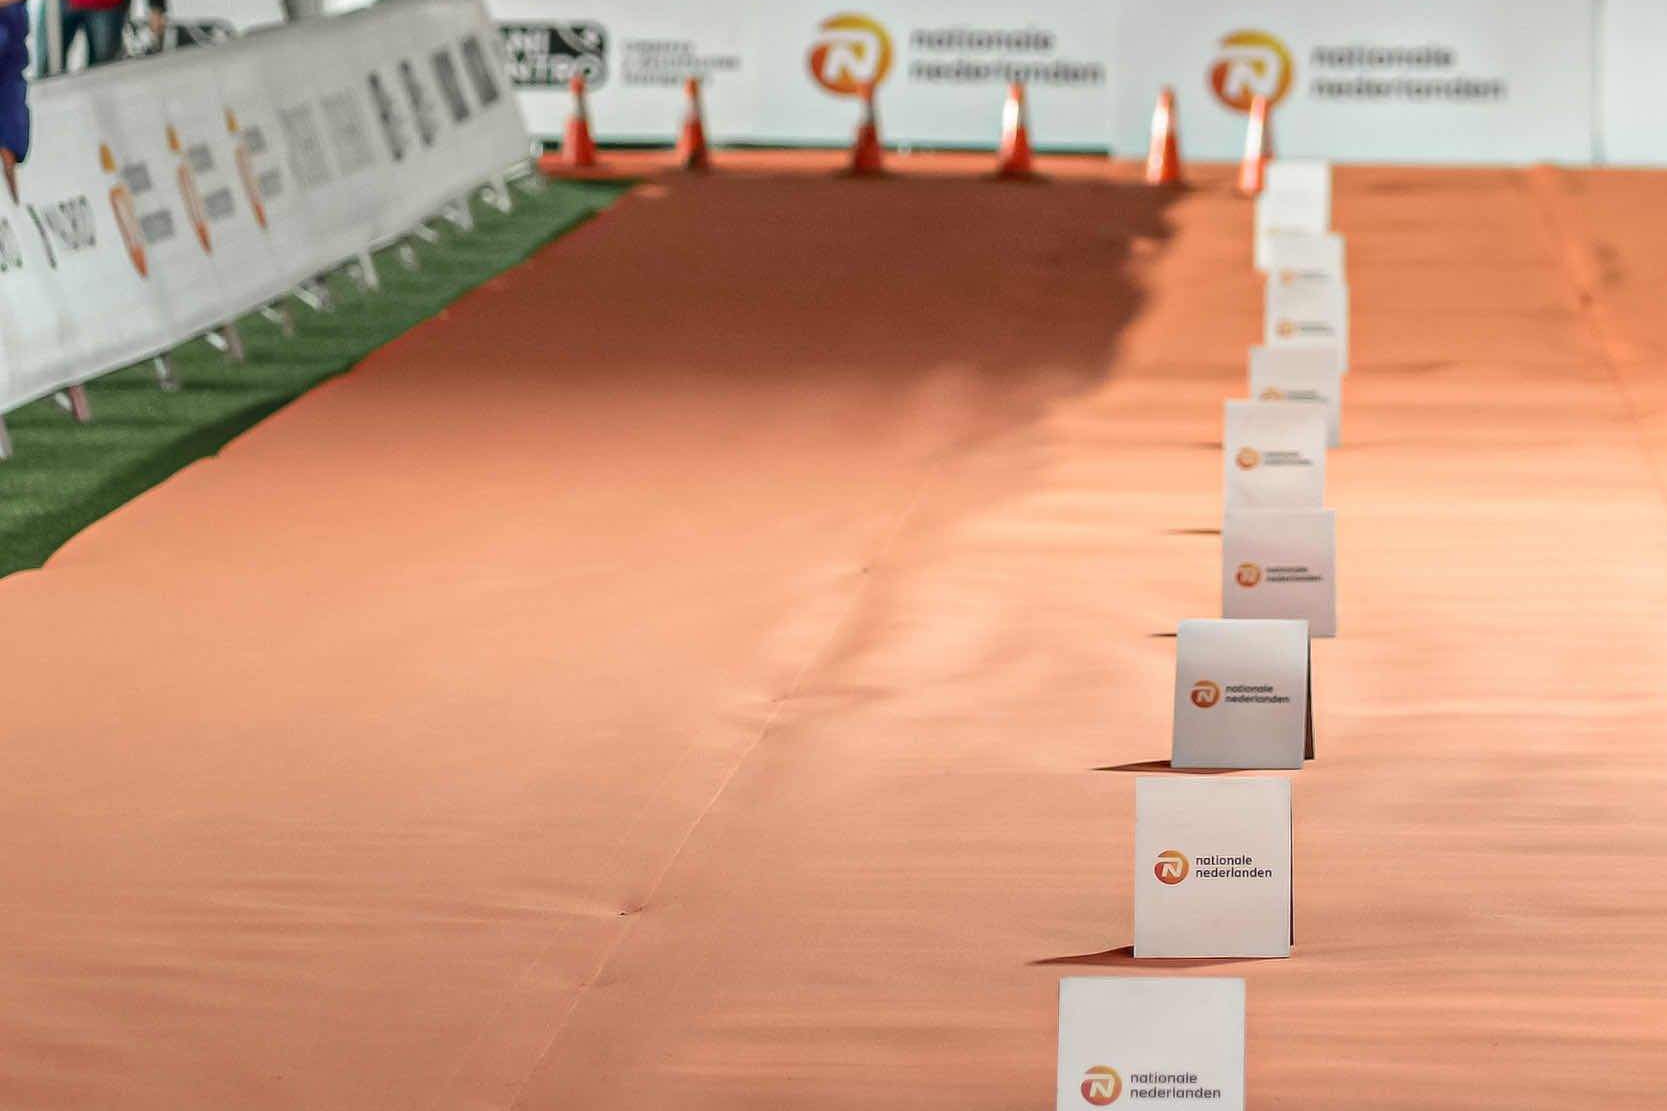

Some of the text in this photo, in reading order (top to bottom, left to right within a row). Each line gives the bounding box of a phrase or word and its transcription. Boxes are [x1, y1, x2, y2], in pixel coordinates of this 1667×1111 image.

[1225, 684, 1274, 693] nationale
[1225, 694, 1291, 704] nederlanden
[1195, 854, 1253, 866] nationale
[1195, 866, 1273, 879] nederlanden
[1130, 1071, 1198, 1085] nationale
[1130, 1086, 1222, 1100] nederlanden
